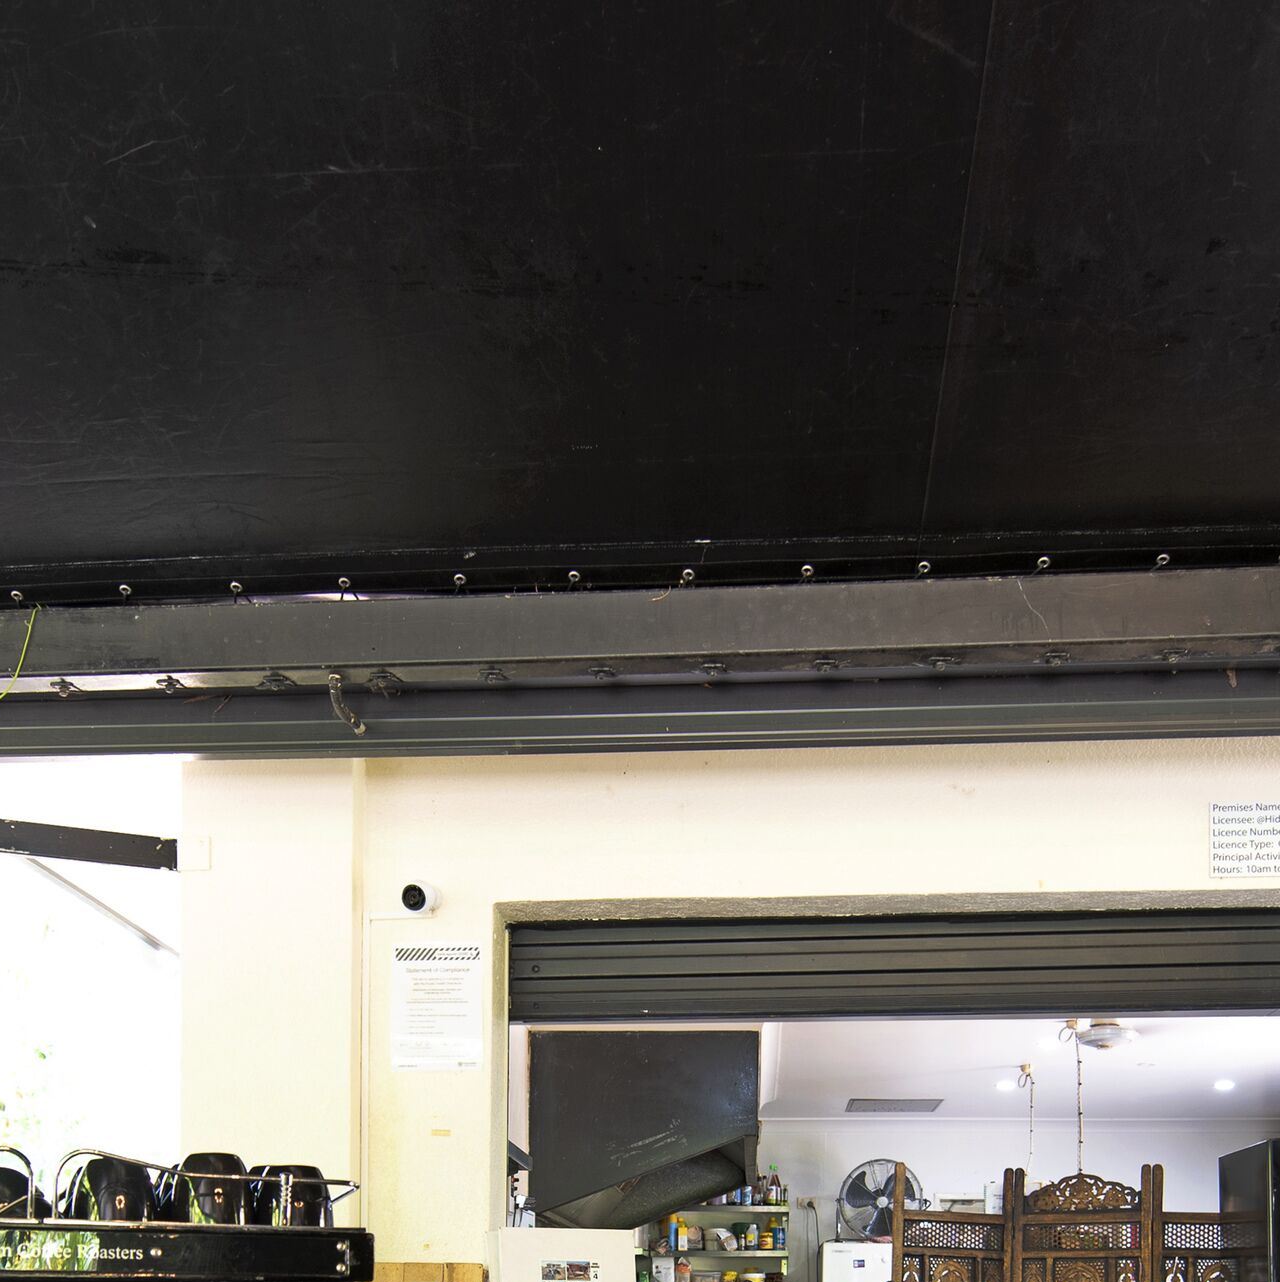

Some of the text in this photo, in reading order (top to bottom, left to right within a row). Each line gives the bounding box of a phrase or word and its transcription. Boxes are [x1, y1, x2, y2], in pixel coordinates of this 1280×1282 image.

[1212, 803, 1253, 812] Premises
[1212, 816, 1254, 825] Licensee:
[1212, 828, 1247, 837] Licence
[1212, 841, 1247, 849] Licence
[1249, 840, 1274, 850] Type:
[1212, 853, 1252, 862] Principal
[1212, 865, 1242, 874] Hours:
[1246, 864, 1271, 873] 10am
[76, 1244, 144, 1260] Roasters
